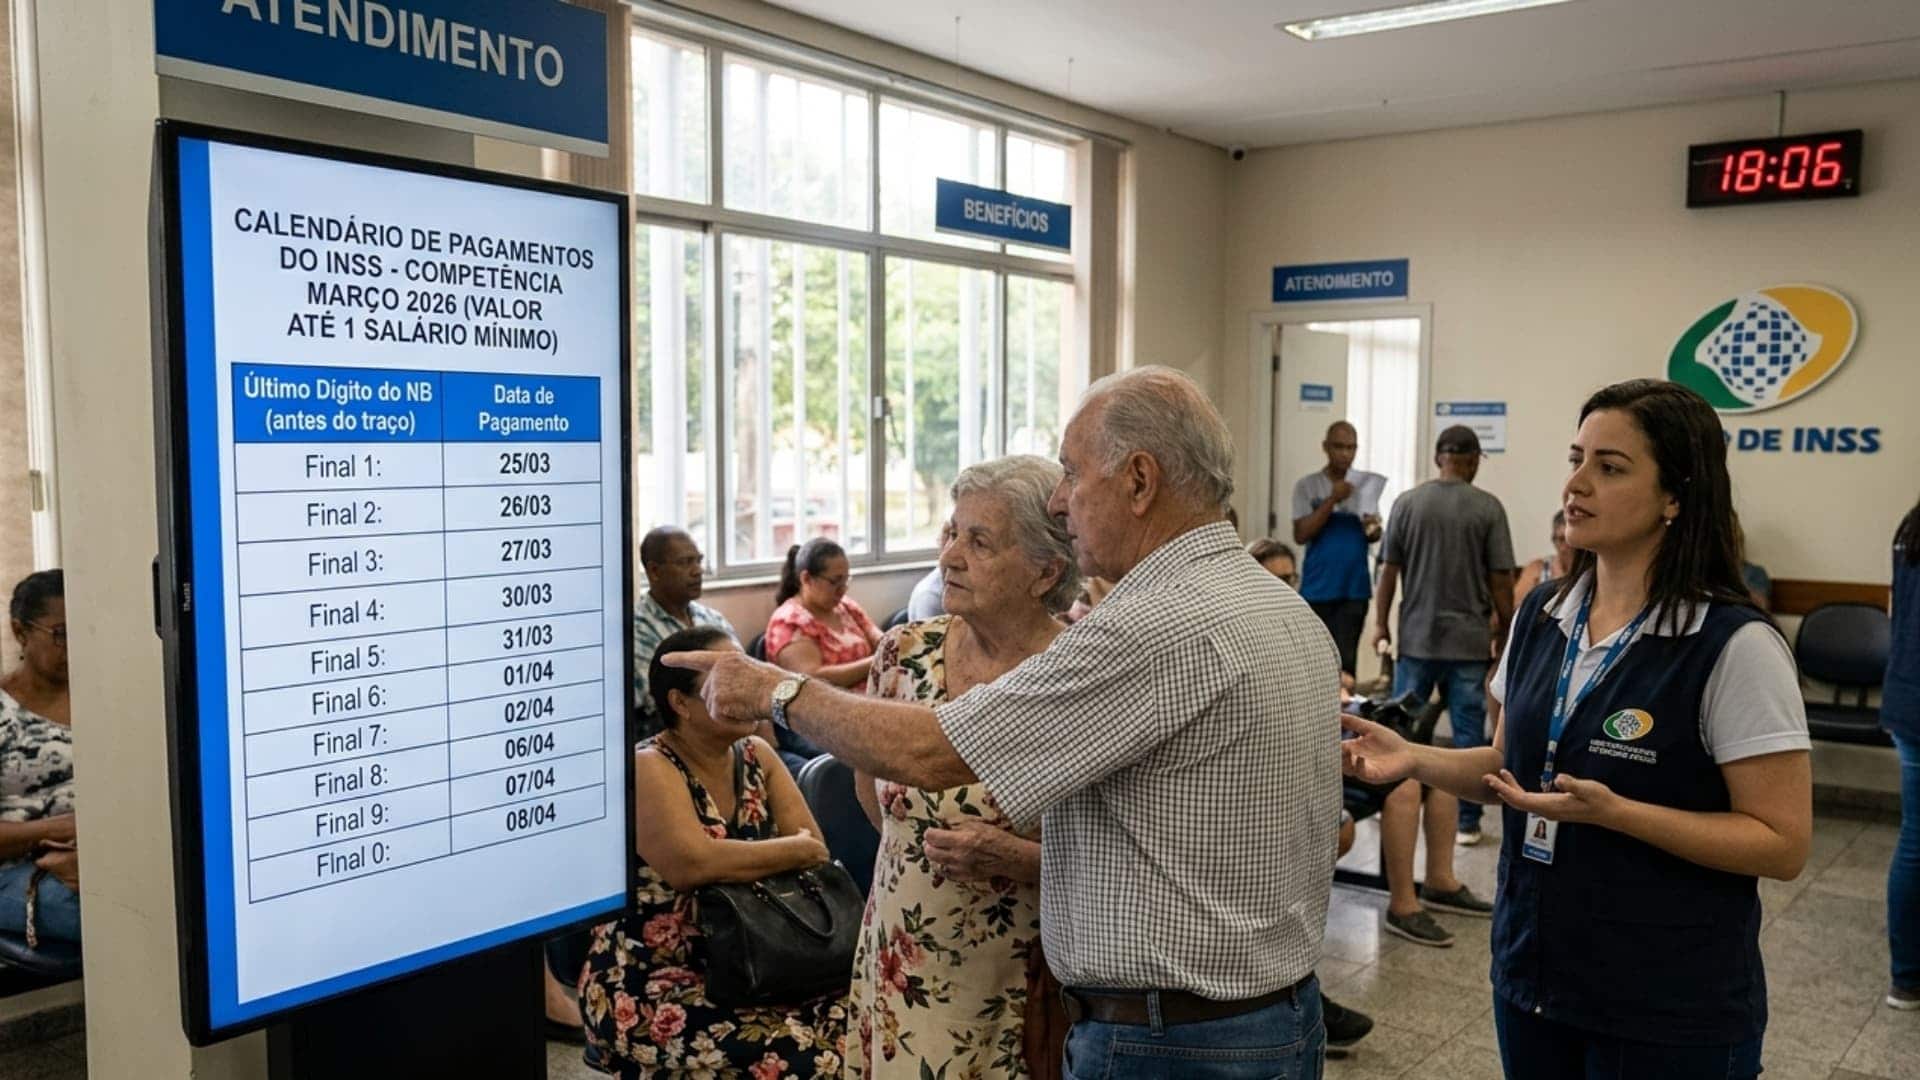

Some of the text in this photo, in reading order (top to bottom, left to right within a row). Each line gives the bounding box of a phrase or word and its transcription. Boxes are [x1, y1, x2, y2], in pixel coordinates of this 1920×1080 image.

[1720, 141, 1843, 193] 18:06
[963, 197, 1050, 234] BENEFÍCIOS
[234, 207, 595, 271] CALENDÁRIO DE PAGAMENTOS
[279, 245, 319, 273] DO
[326, 249, 383, 278] INSS
[1284, 270, 1395, 293] ATENDIMENTO
[307, 280, 544, 321] MARÇO 2026 (VALOR
[286, 308, 559, 357] ATÉ 1 SALÁRIO MÍNIMO)
[243, 370, 312, 400] Último
[377, 380, 402, 402] do
[406, 381, 434, 402] NB
[493, 383, 555, 405] Data de
[264, 408, 417, 437] (antes do traço)
[478, 411, 571, 437] Pagamento
[1737, 427, 1783, 452] DE
[1792, 425, 1882, 455] INSS
[305, 454, 382, 479] Final 1:
[499, 452, 551, 475] 25/03
[307, 500, 383, 527] Final 2:
[500, 494, 552, 518] 26/03
[307, 549, 384, 577] Final 3:
[500, 538, 553, 562] 27/03
[501, 582, 554, 609] 30/03
[309, 598, 385, 629] Final 4:
[502, 624, 554, 651] 31/03
[310, 644, 386, 676] Final 5:
[503, 659, 555, 687] 01/04
[311, 684, 388, 716] Final 6:
[504, 695, 555, 724] 02/04
[312, 724, 389, 757] Final 7:
[505, 731, 556, 760] 06/04
[314, 763, 389, 798] Final 8:
[505, 766, 557, 797] 07/04
[315, 802, 390, 838] Final 9:
[506, 802, 557, 832] 08/04
[371, 841, 391, 865] 0:
